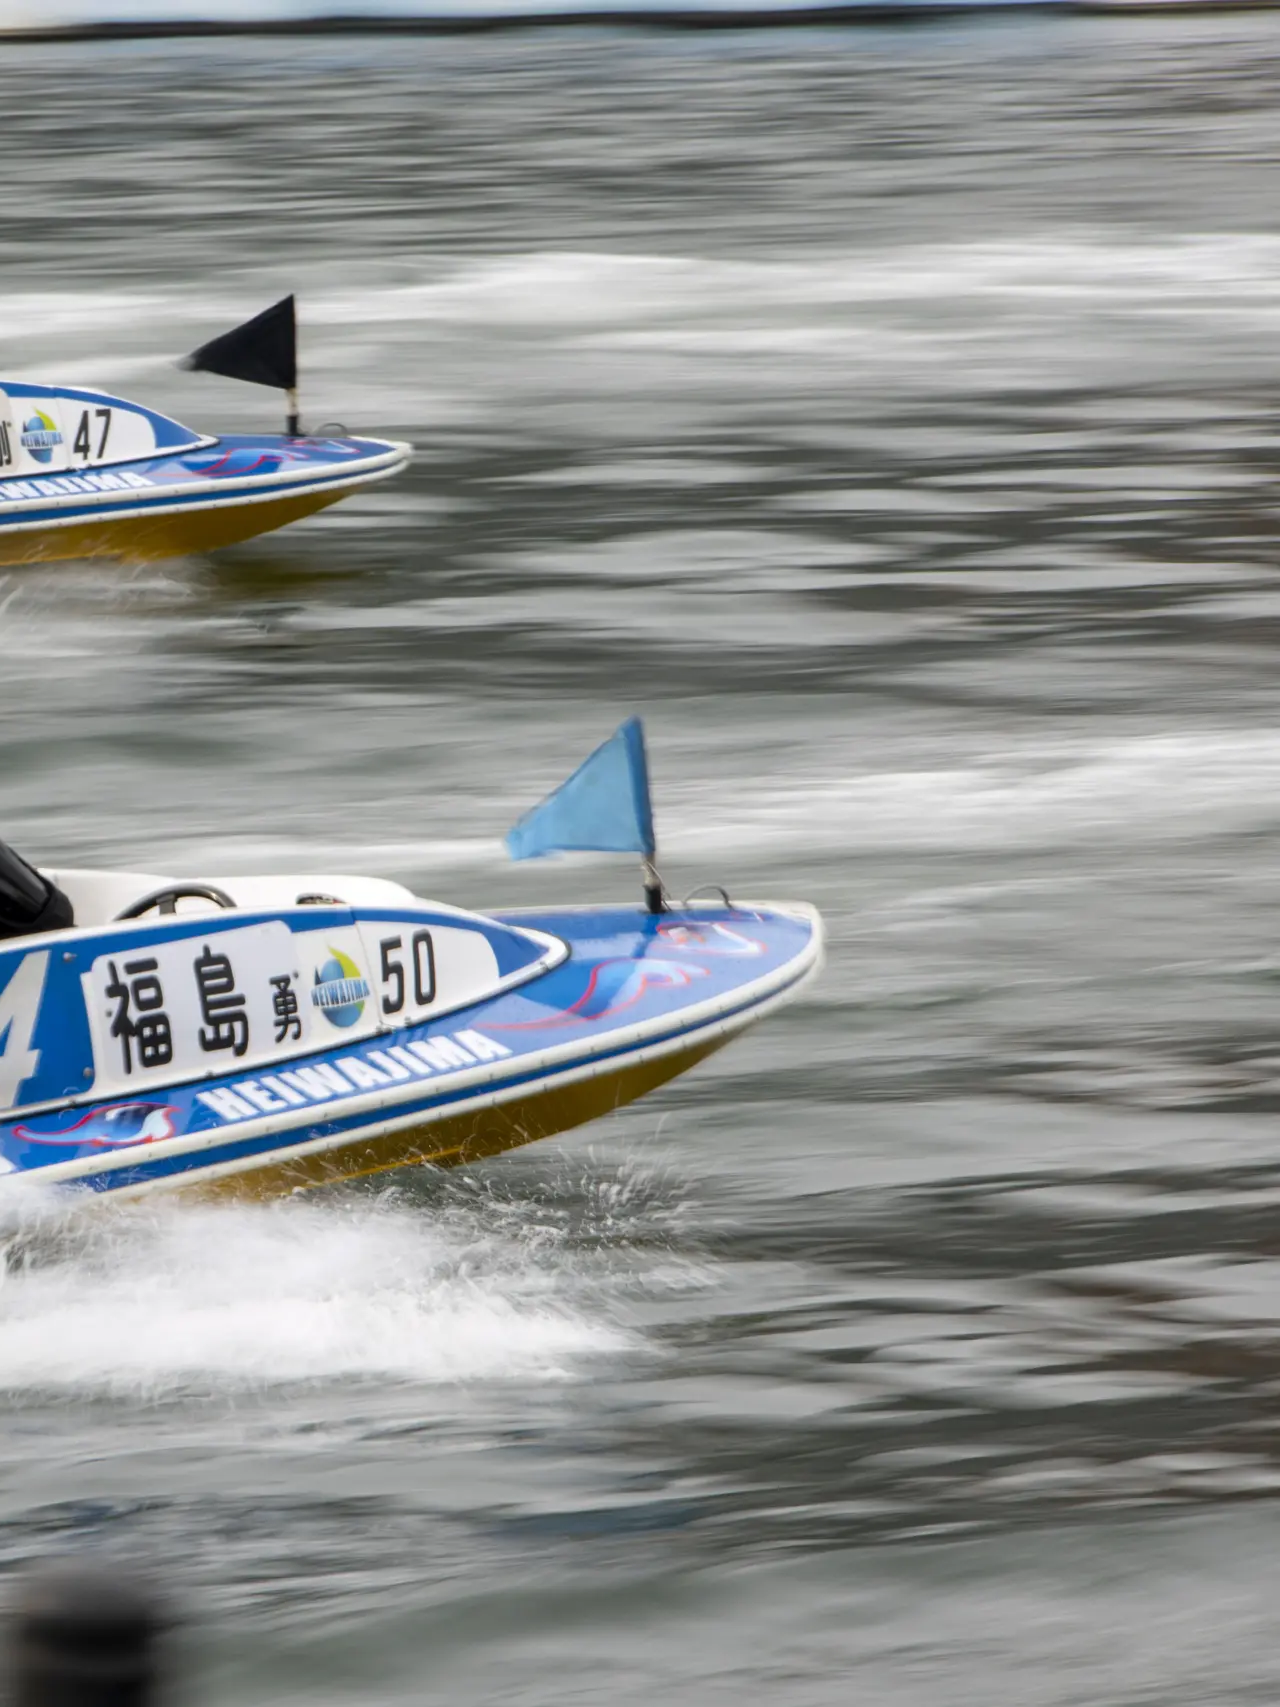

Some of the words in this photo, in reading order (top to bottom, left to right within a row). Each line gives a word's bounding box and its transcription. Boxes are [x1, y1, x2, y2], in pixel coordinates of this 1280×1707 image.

[73, 408, 112, 461] 47
[310, 978, 371, 1008] HEIWAJIMA
[380, 928, 436, 1015] 50
[196, 1029, 513, 1122] HEIWAJIMA
